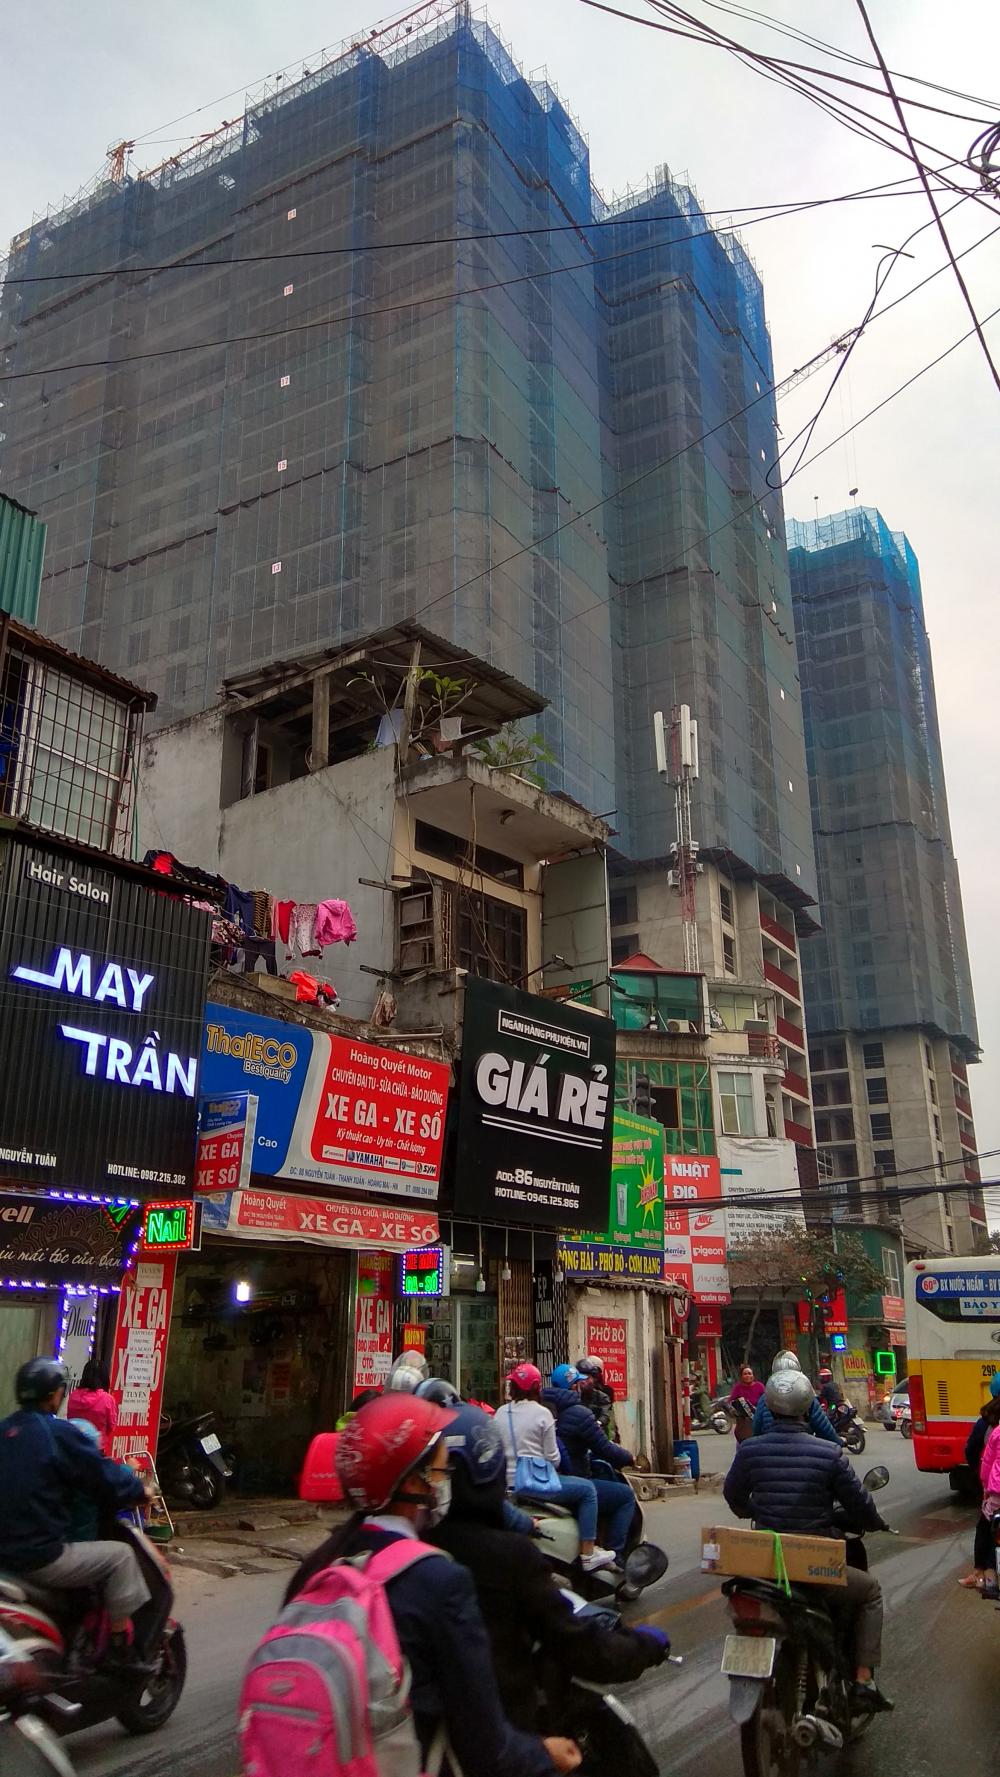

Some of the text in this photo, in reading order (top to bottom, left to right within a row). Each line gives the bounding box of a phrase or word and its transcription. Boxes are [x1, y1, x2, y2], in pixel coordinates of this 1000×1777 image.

[30, 861, 110, 904] Hair Salon
[11, 947, 154, 1013] MAY
[206, 1023, 298, 1071] ThaiECO
[524, 1023, 546, 1040] HÀNG
[545, 1031, 560, 1045] PHỤ
[57, 1024, 198, 1098] TRẦN
[243, 1059, 291, 1085] Best quality
[350, 1048, 432, 1080] Hoàng Quyết Motor
[331, 1067, 356, 1086] CHUYÊN
[380, 1077, 391, 1093] SỬA
[391, 1081, 408, 1098] CHỮA
[410, 1084, 423, 1101] BẢO
[423, 1089, 443, 1106] DƯỠNG
[476, 1052, 610, 1130] GIÁ RẺ
[324, 1092, 350, 1122] XE
[354, 1099, 377, 1128] GA
[393, 1108, 416, 1135] XE
[420, 1109, 444, 1140] SỐ
[200, 1141, 240, 1161] XE GA
[257, 1136, 278, 1148] Cao
[336, 1127, 345, 1141] Kỹ
[345, 1129, 362, 1144] thuật
[362, 1135, 373, 1144] cao
[376, 1136, 386, 1148] Uy
[396, 1139, 410, 1152] Chất
[410, 1142, 426, 1156] lượng
[107, 1163, 140, 1179] HOTLINE:
[196, 1161, 239, 1187] XE SỐ
[356, 1151, 384, 1167] YAMAHA
[422, 1165, 436, 1174] SYM
[671, 1160, 711, 1181] NHẬT
[243, 1193, 287, 1211] Hoàng Quyết
[325, 1204, 415, 1223] CHUYÊN SỬA CHỮA BẢO DƯỠNG
[300, 1212, 329, 1232] XE
[332, 1217, 364, 1236] GA
[381, 1222, 406, 1240] XE
[410, 1223, 438, 1242] SỐ
[17, 1247, 48, 1262] mái
[49, 1248, 70, 1263] tóc
[72, 1252, 95, 1265] của
[99, 1248, 123, 1270] bạn
[598, 1246, 614, 1273] PHỞ
[614, 1248, 624, 1273] BÒ
[628, 1253, 643, 1274] CƠM
[643, 1255, 661, 1275] RANG
[693, 1244, 724, 1257] pigeon
[940, 1279, 949, 1291] BX
[949, 1275, 966, 1292] NƯỚC
[121, 1286, 168, 1330] XE GA
[359, 1299, 390, 1334] XE GA
[963, 1298, 988, 1309] BẢO
[590, 1323, 625, 1343] PHỞ BÒ
[609, 1369, 624, 1382] Xào
